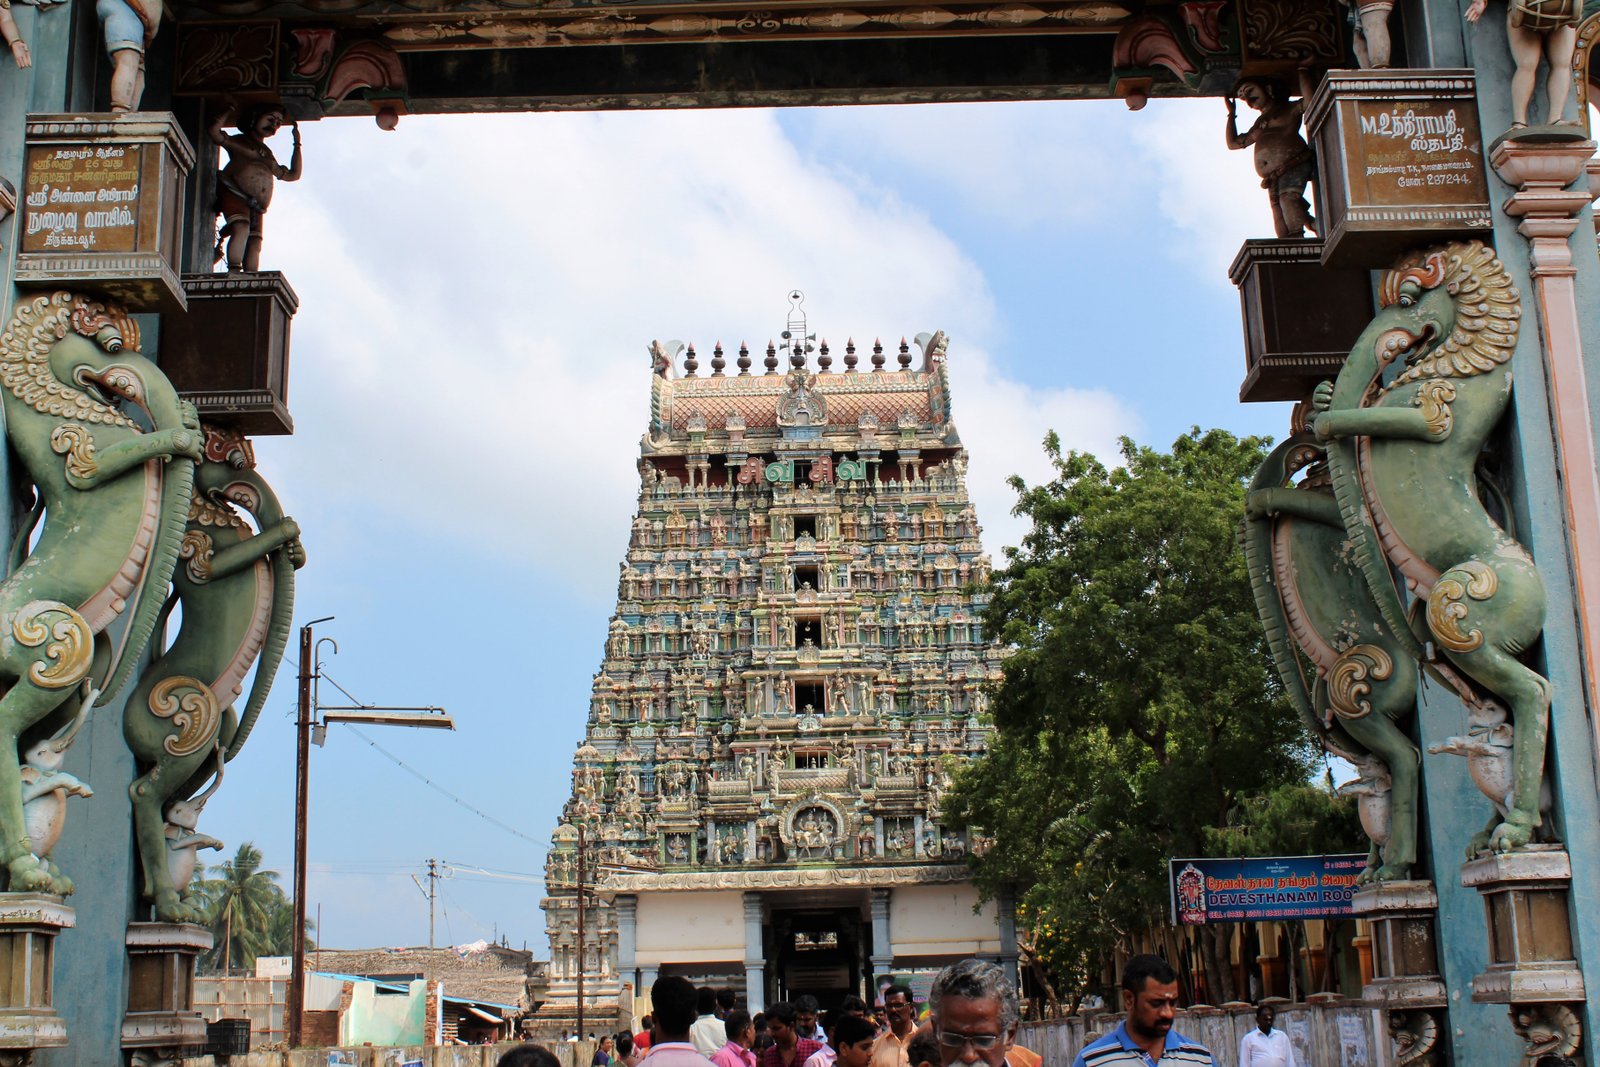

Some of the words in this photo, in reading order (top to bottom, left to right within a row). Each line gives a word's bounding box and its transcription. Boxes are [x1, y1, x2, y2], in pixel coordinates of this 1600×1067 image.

[50, 186, 96, 203] அன்னை
[97, 183, 138, 203] அபிராமி
[27, 212, 77, 234] நுழைவு
[1277, 871, 1318, 890] தங்கும்
[1321, 873, 1358, 890] அறை
[1209, 891, 1318, 906] DEVESTHANAM
